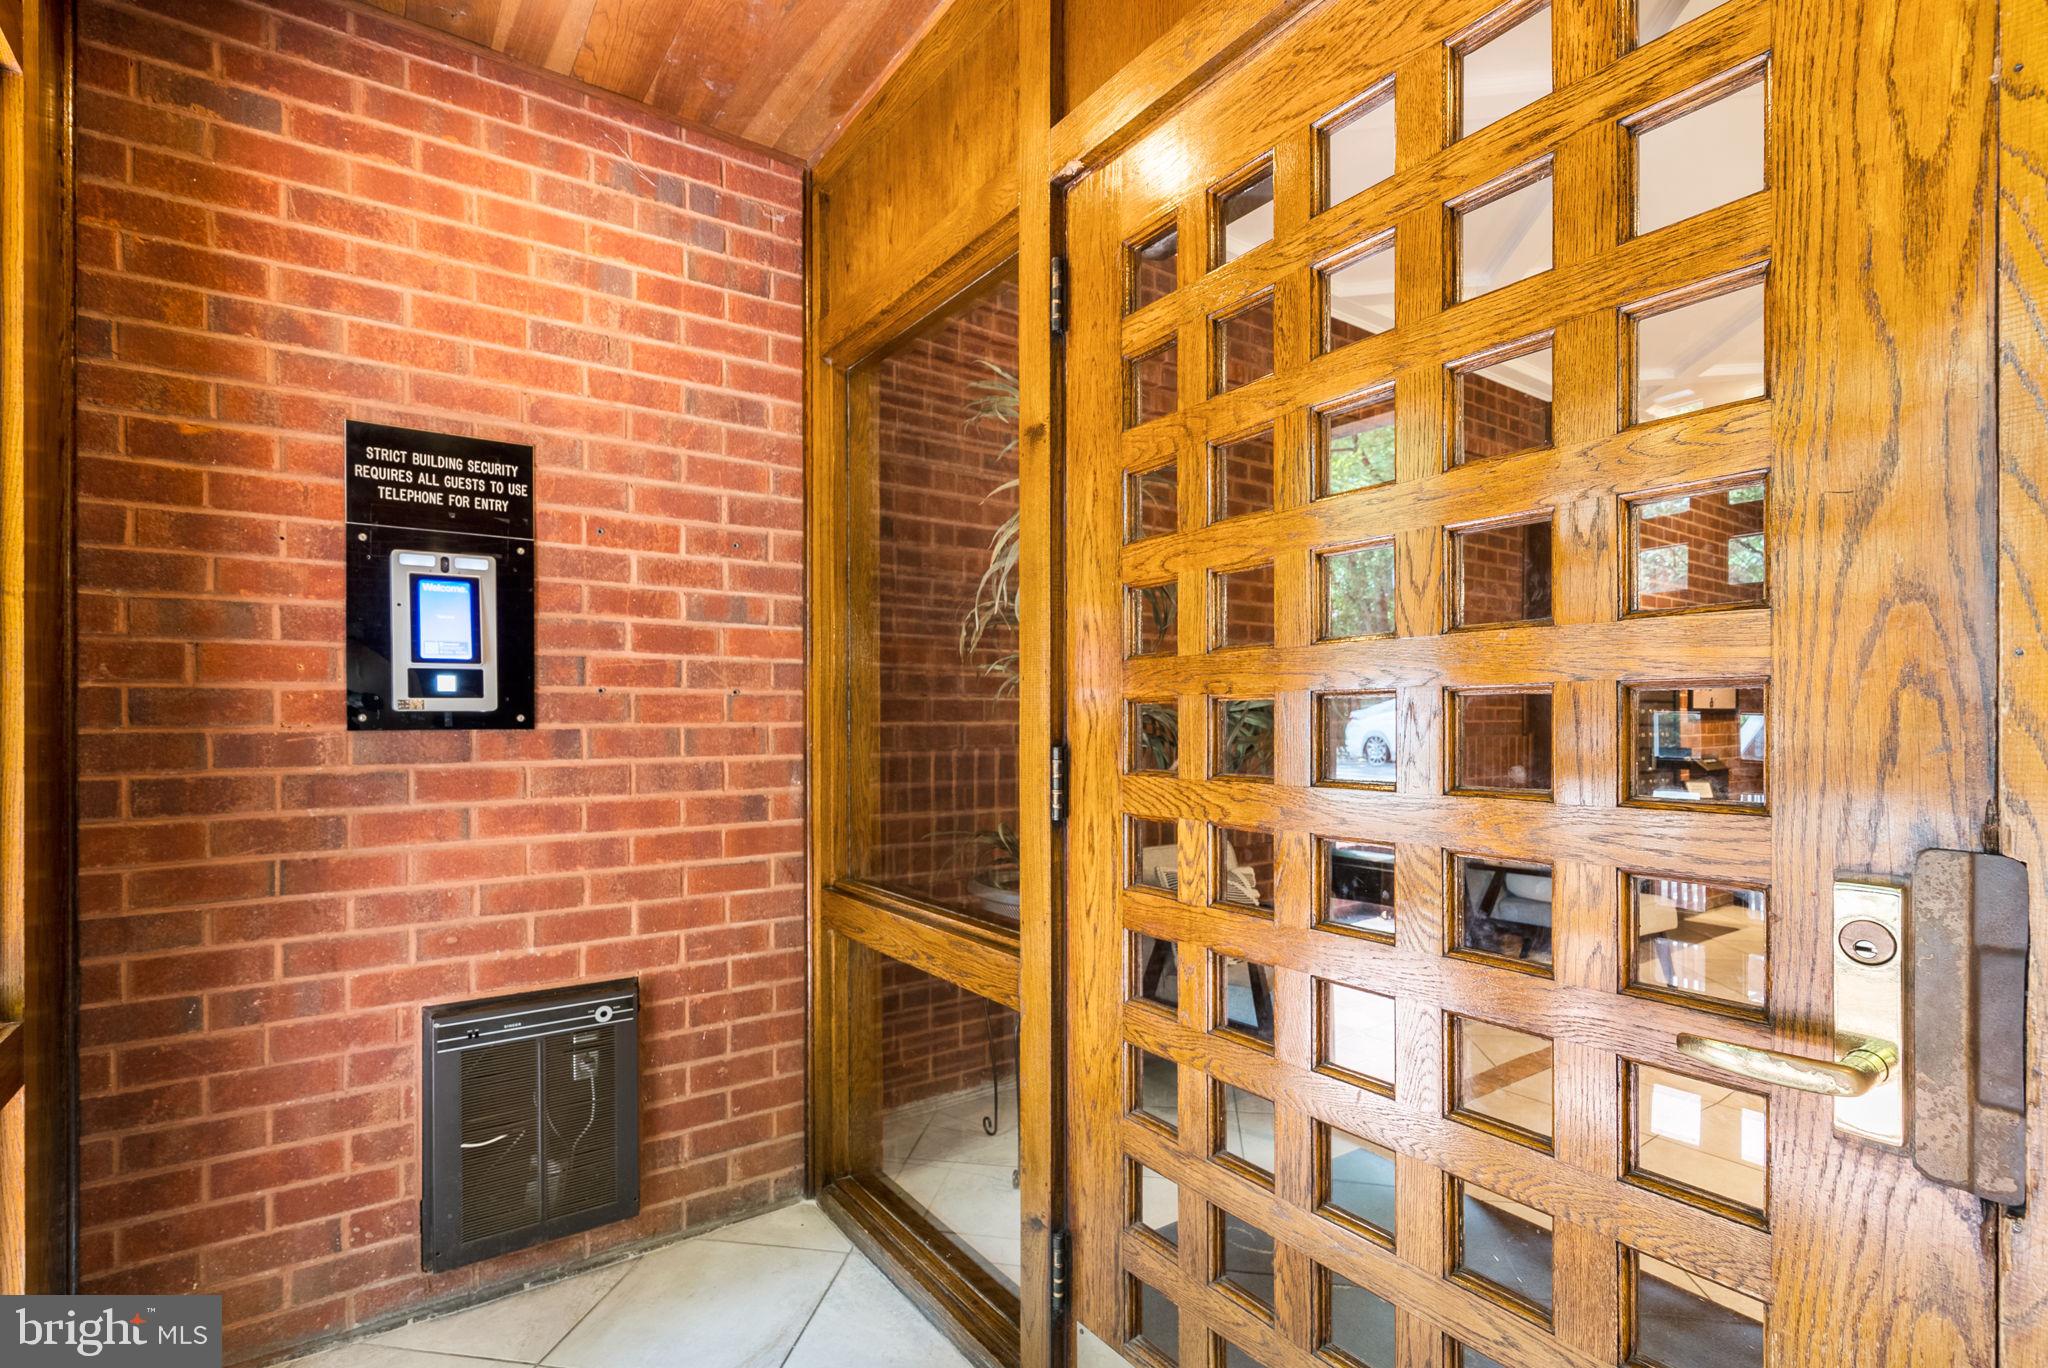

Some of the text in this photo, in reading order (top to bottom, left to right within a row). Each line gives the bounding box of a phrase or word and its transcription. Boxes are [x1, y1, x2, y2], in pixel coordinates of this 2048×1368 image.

[366, 446, 518, 477] STRICT BUILDING SECURITY
[354, 464, 528, 497] REQUIRES ALL GUESTS TO USE
[378, 486, 509, 513] TELEPHONE FOR ENTRY
